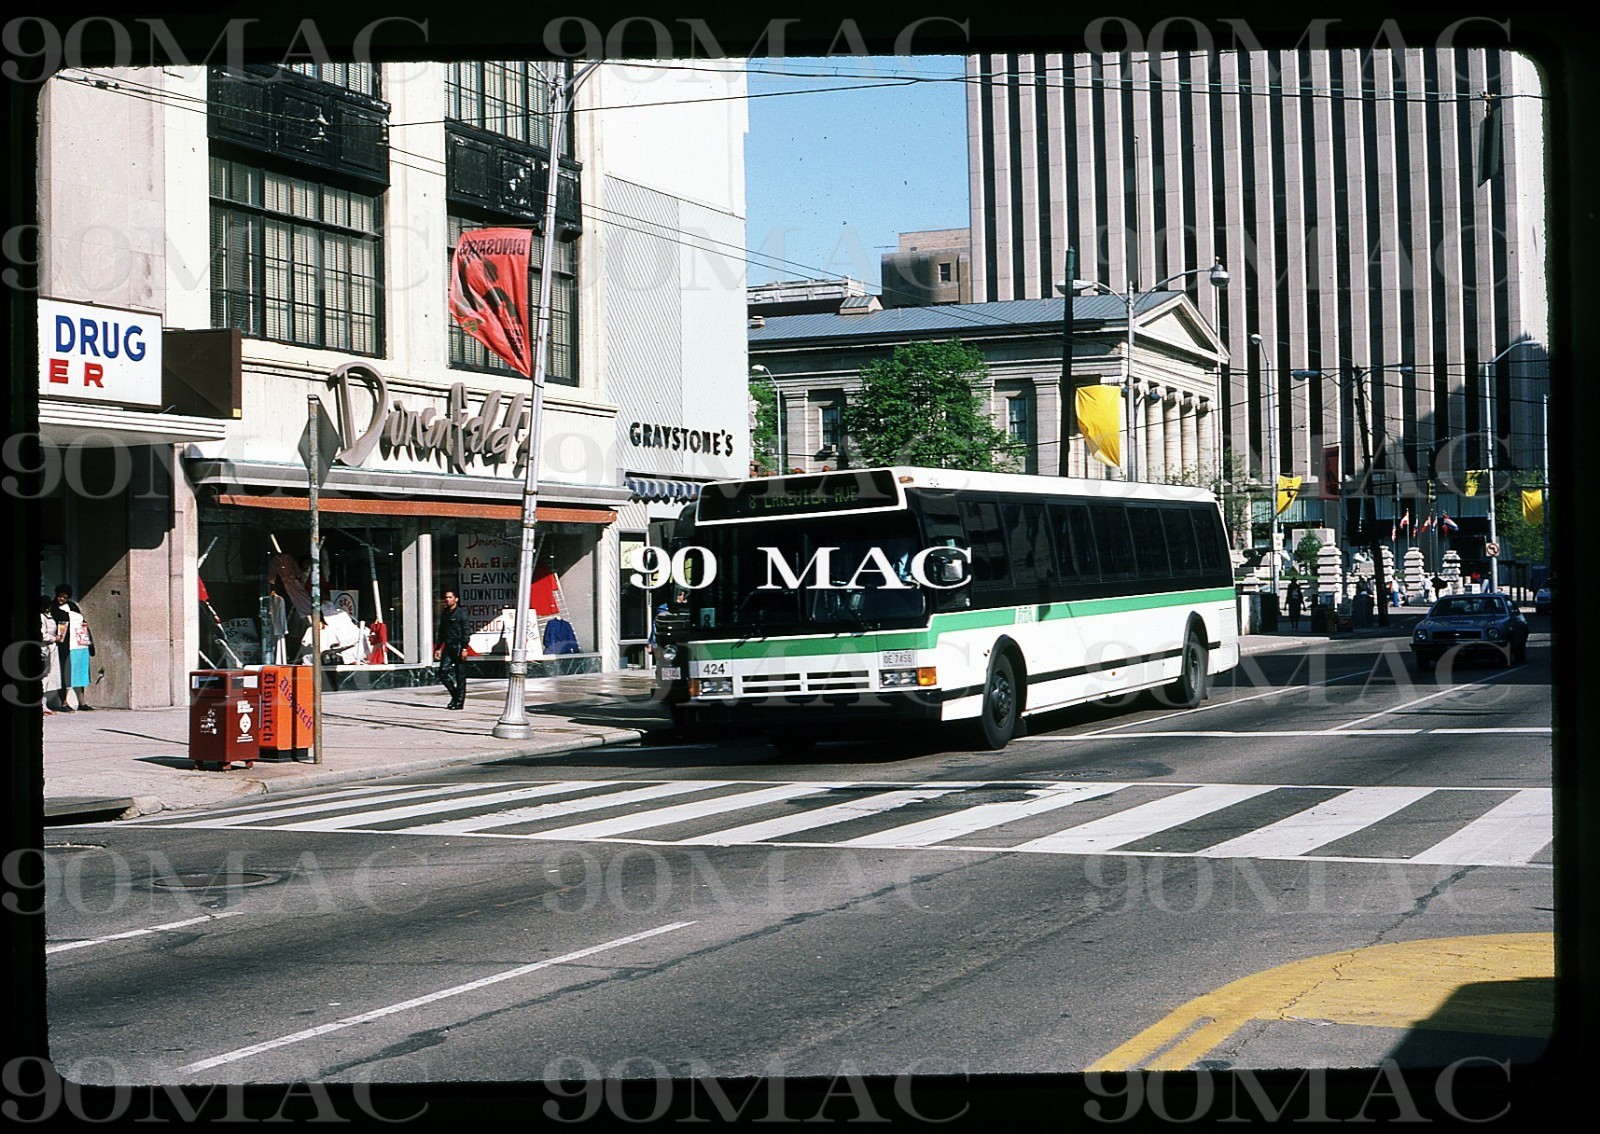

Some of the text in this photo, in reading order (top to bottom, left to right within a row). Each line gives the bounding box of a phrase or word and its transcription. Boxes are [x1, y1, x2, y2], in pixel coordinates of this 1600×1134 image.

[55, 314, 146, 362] DRUG
[629, 422, 733, 457] GRAYSTONE'S
[463, 557, 488, 569] After
[461, 573, 518, 585] LEAVING
[463, 588, 516, 601] DOWNTOWN
[703, 663, 725, 675] 424
[262, 672, 276, 742] Dispatch
